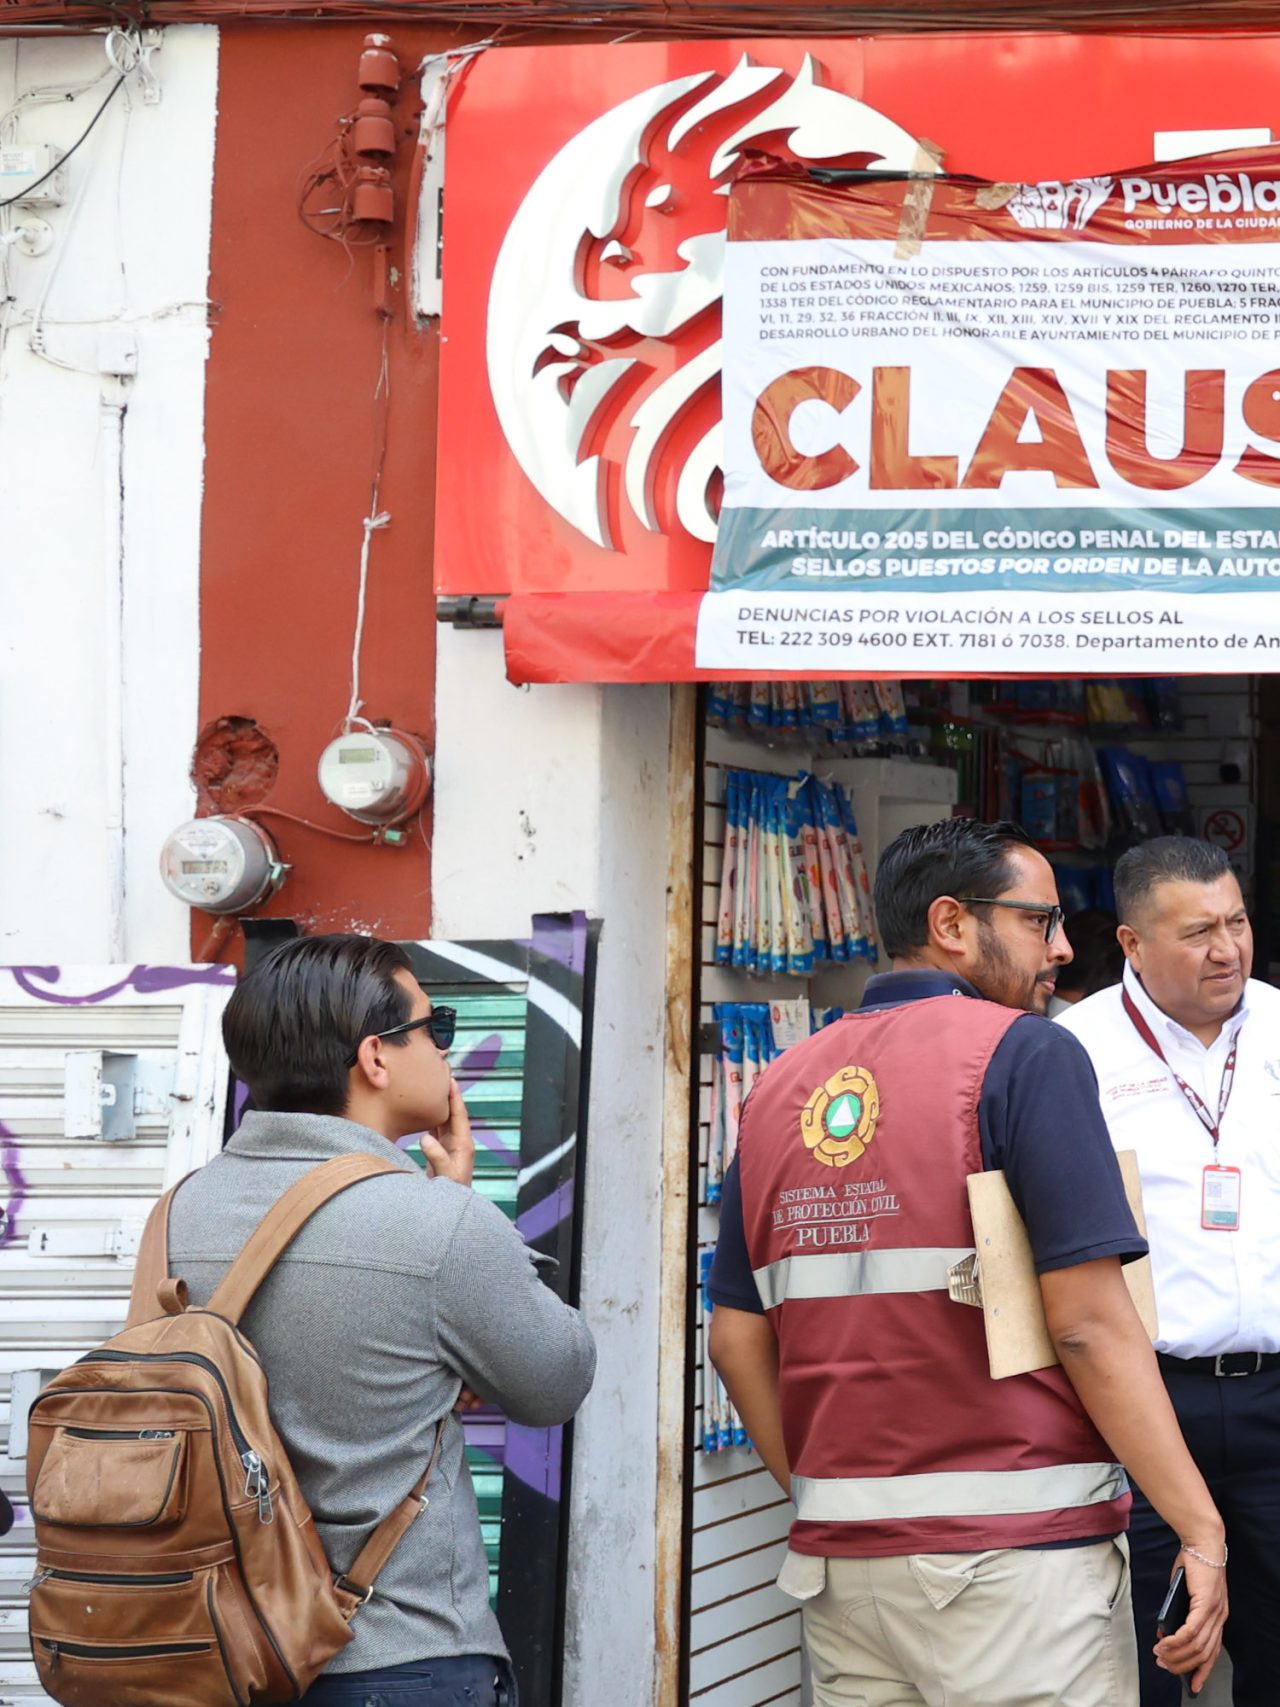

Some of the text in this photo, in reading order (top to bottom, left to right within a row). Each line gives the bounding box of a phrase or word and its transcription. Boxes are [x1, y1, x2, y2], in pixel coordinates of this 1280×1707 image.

[1125, 219, 1193, 230] GOBIERNO
[1197, 219, 1213, 229] DE
[1216, 219, 1233, 229] LA
[792, 264, 884, 276] FUNDAMENTO
[932, 266, 1008, 278] DISPUESTO
[810, 279, 870, 291] ESTADOS
[1054, 283, 1083, 294] 1259
[1116, 282, 1145, 294] 1259
[1218, 282, 1247, 292] 1270
[847, 293, 898, 306] CÓDIGO
[1021, 298, 1058, 309] PARA
[1080, 298, 1152, 309] MUNICIPIO
[860, 309, 928, 322] FRACCIÓN
[1175, 313, 1270, 324] REGLAMENTO
[760, 328, 848, 340] DESARROLLO
[852, 326, 909, 338] URBANO
[1030, 328, 1140, 340] AYUNTAMIENTO
[1173, 330, 1247, 340] MUNICIPIO
[761, 526, 880, 549] ARTÍCULO
[884, 531, 928, 549] 205
[932, 531, 979, 549] DEL
[983, 526, 1075, 549] CÓDIGO
[1079, 531, 1160, 548] PENAL
[1164, 530, 1211, 548] DEL
[791, 557, 882, 577] SELLOS
[885, 558, 996, 577] PUESTOS
[998, 558, 1049, 574] POR
[1053, 557, 1139, 574] ORDEN
[1143, 557, 1177, 575] DE
[1181, 558, 1213, 576] LA
[737, 606, 1184, 625] DENUNCIAS POR VIOLACIÓN A LOS SELLOS AL
[736, 630, 775, 645] TEL:
[780, 631, 812, 646] 222
[818, 632, 852, 646] 309
[858, 632, 907, 647] 4600
[912, 633, 953, 647] EXT.
[958, 633, 996, 648] 7181
[1001, 634, 1014, 648] ó
[1019, 634, 1070, 648] 7038.
[1076, 634, 1218, 651] Departamento
[1224, 634, 1248, 648] de
[780, 1186, 837, 1204] SISTEMA
[787, 1196, 868, 1221] PROTECCIÓN
[796, 1224, 870, 1247] PUEBLA
